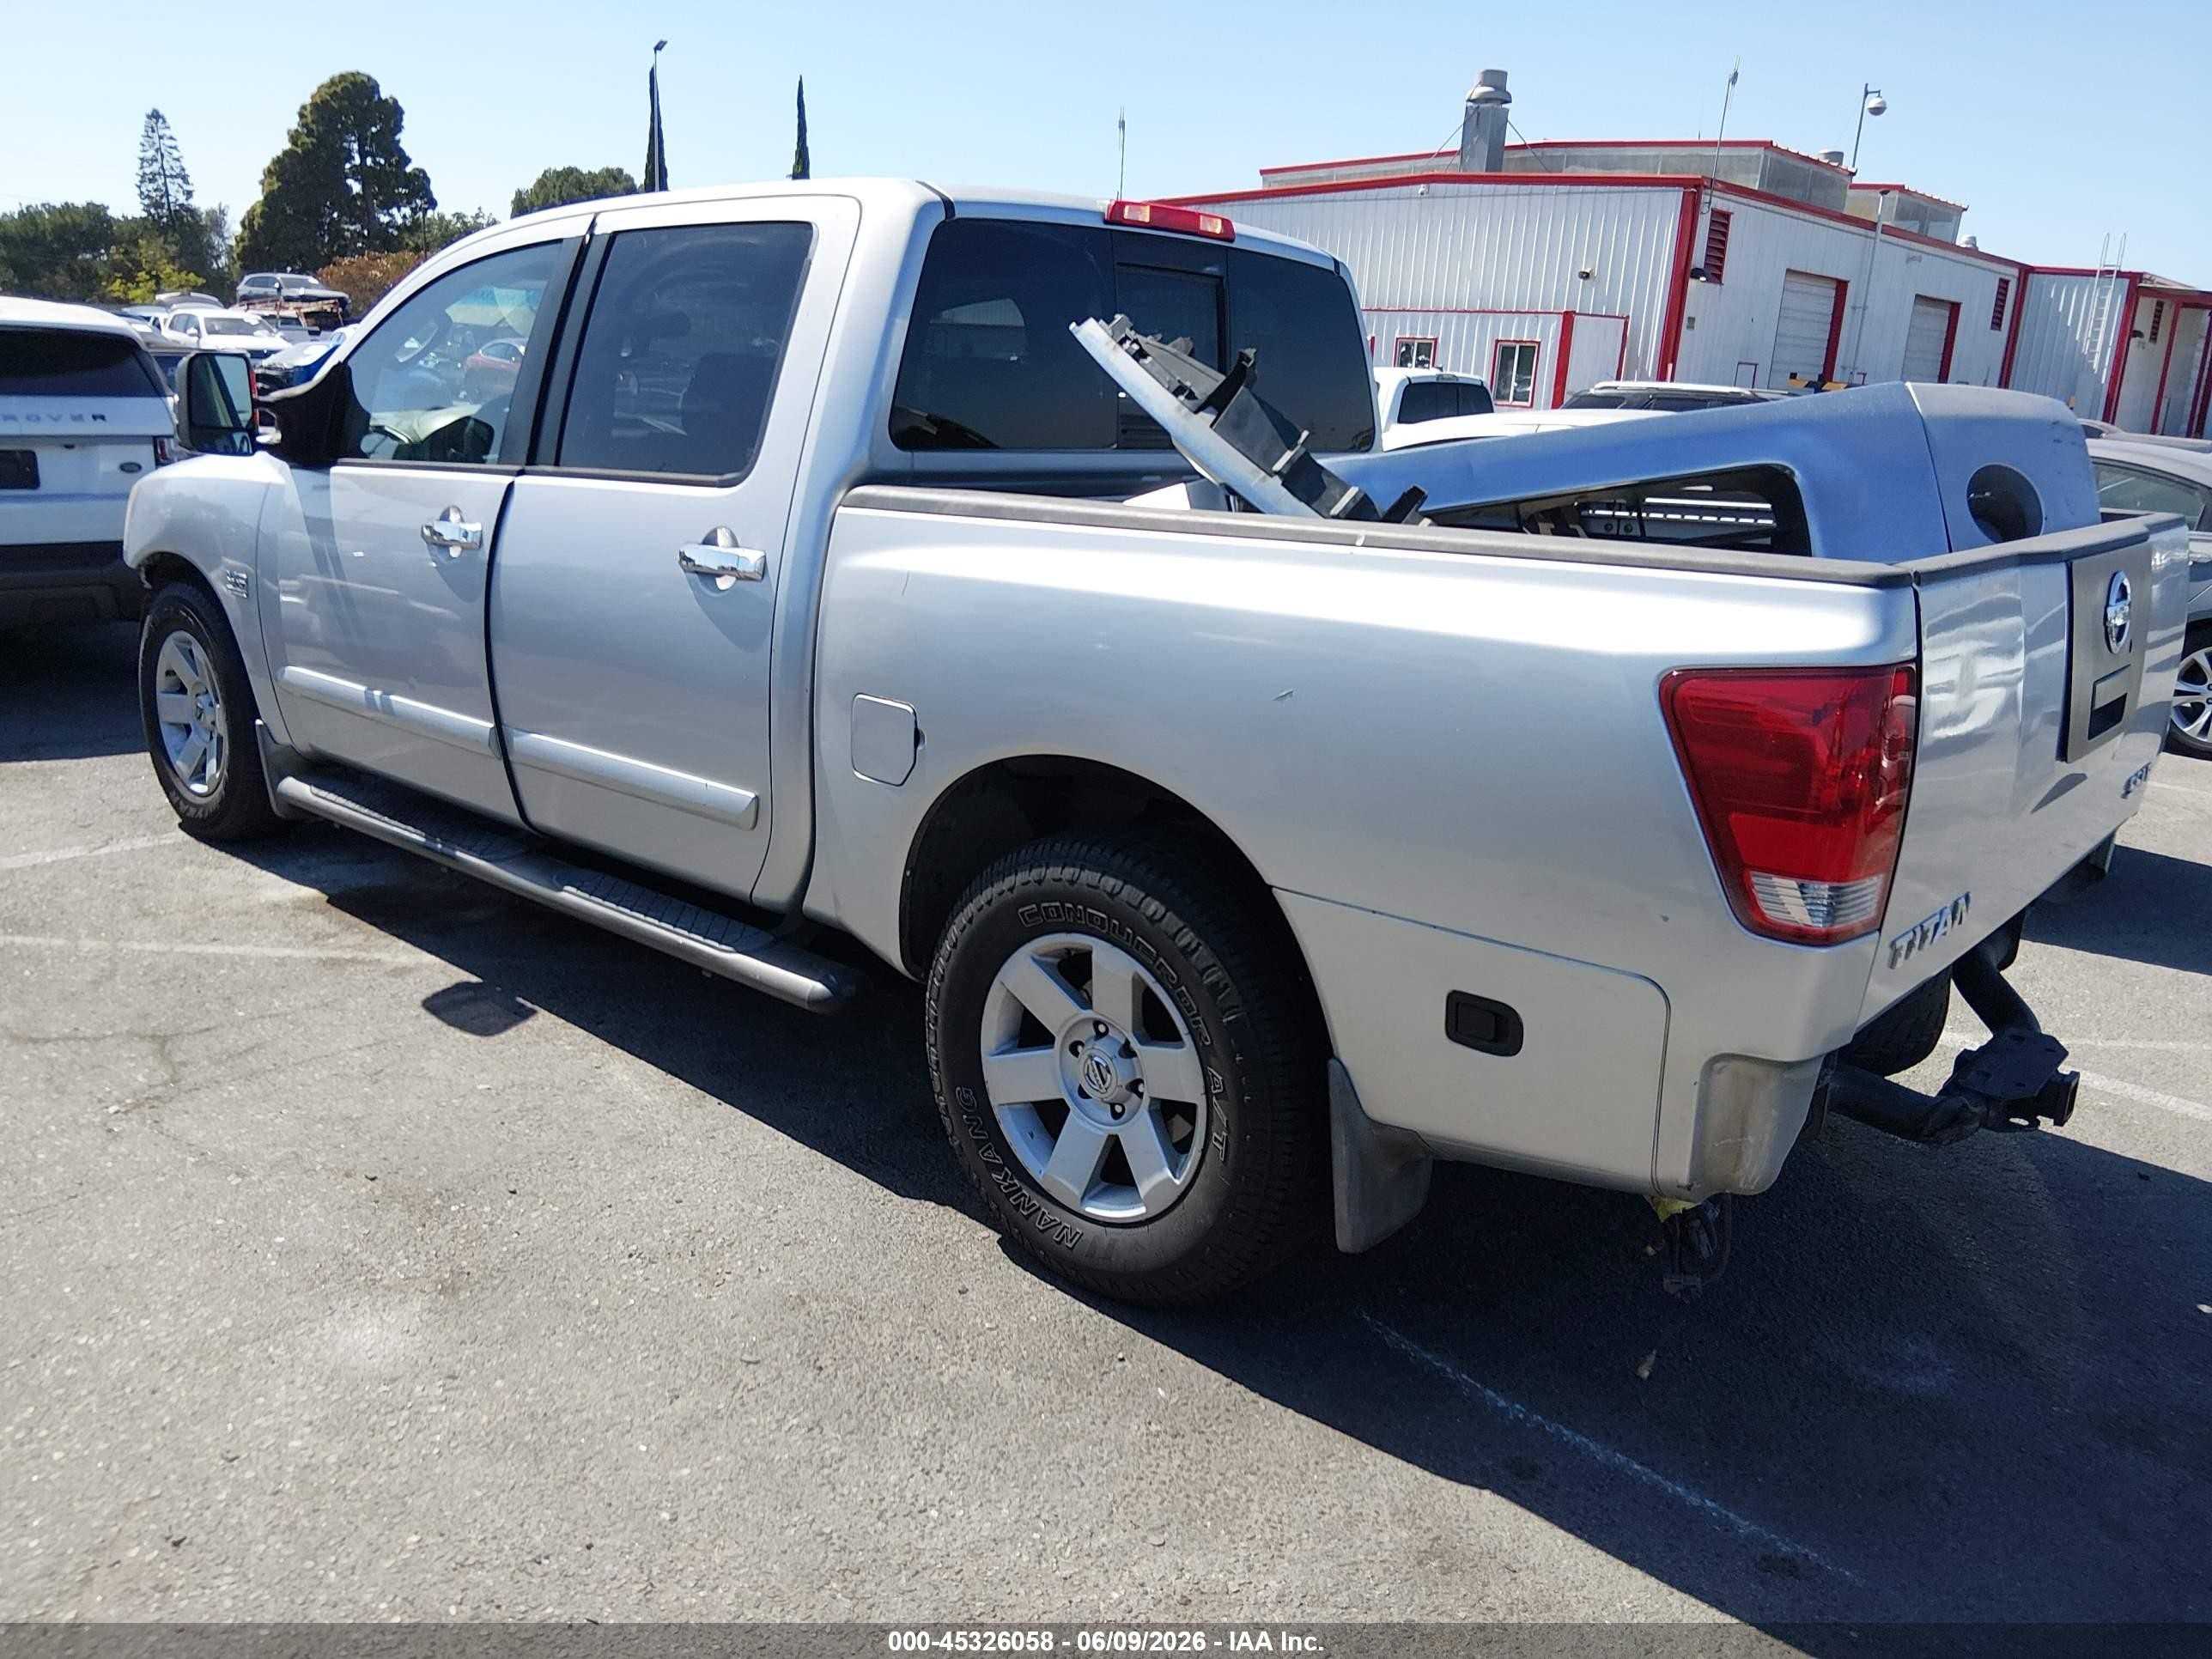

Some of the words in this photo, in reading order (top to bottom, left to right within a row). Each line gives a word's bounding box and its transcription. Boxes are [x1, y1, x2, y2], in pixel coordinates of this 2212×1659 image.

[1888, 891, 1971, 969] TITAN
[1018, 902, 1212, 1046] CONQUEROR
[1207, 1066, 1228, 1162] A/T
[955, 1085, 1082, 1249] NANKANG
